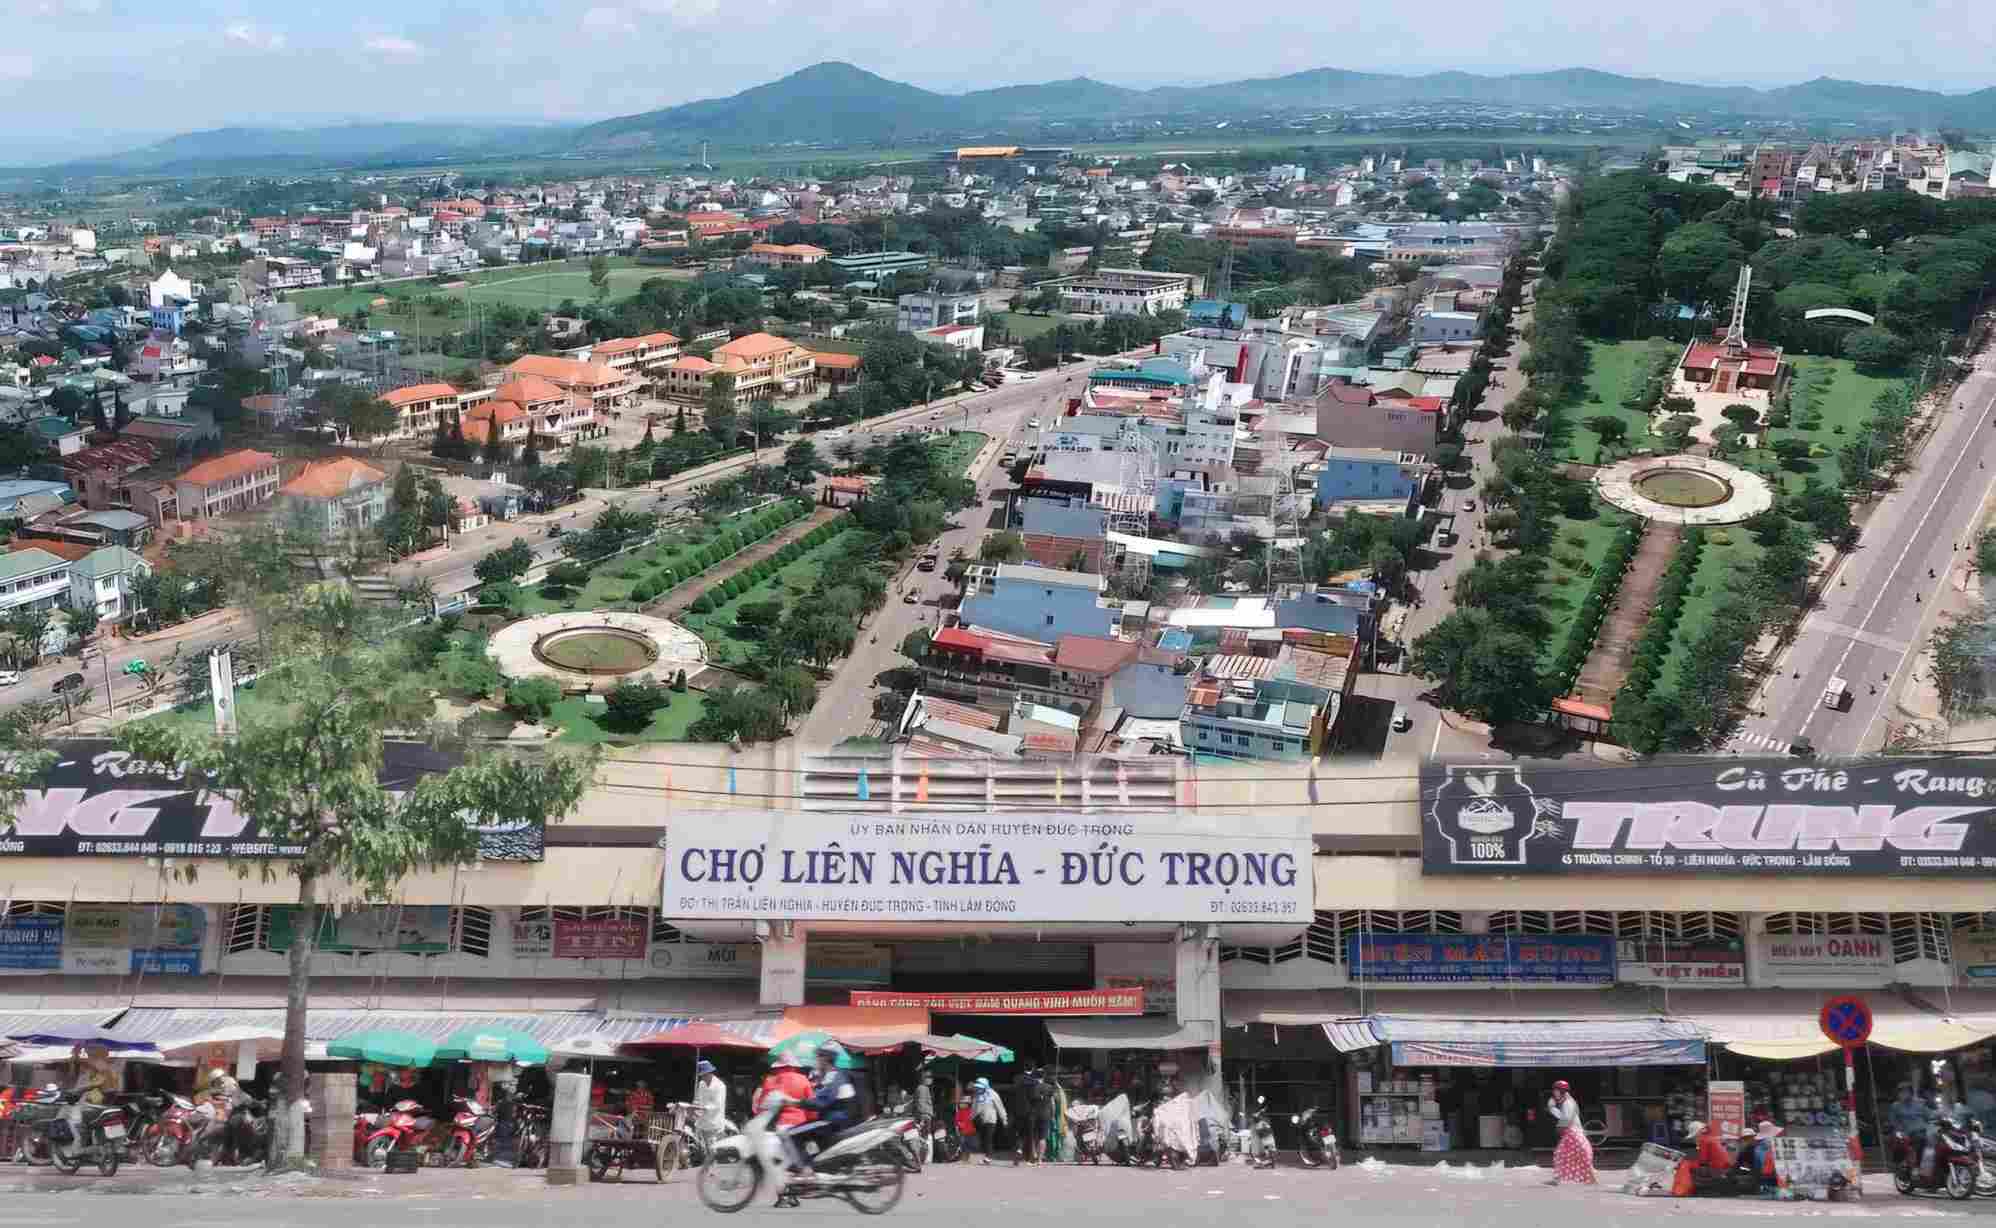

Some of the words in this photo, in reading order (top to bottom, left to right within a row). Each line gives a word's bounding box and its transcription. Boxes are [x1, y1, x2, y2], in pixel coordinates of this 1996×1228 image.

[1780, 768, 1848, 791] Phê
[1892, 769, 1987, 798] Rang
[875, 823, 905, 836] BAN
[1562, 800, 1996, 851] TRUNG
[1470, 842, 1505, 858] 100%
[680, 844, 766, 891] CHỢ
[781, 841, 875, 884] LIÊN
[890, 843, 1020, 884] NGHĨA
[1061, 842, 1144, 886] ĐỨC
[1160, 852, 1297, 894] TRỌNG
[1828, 938, 1883, 957] OANH
